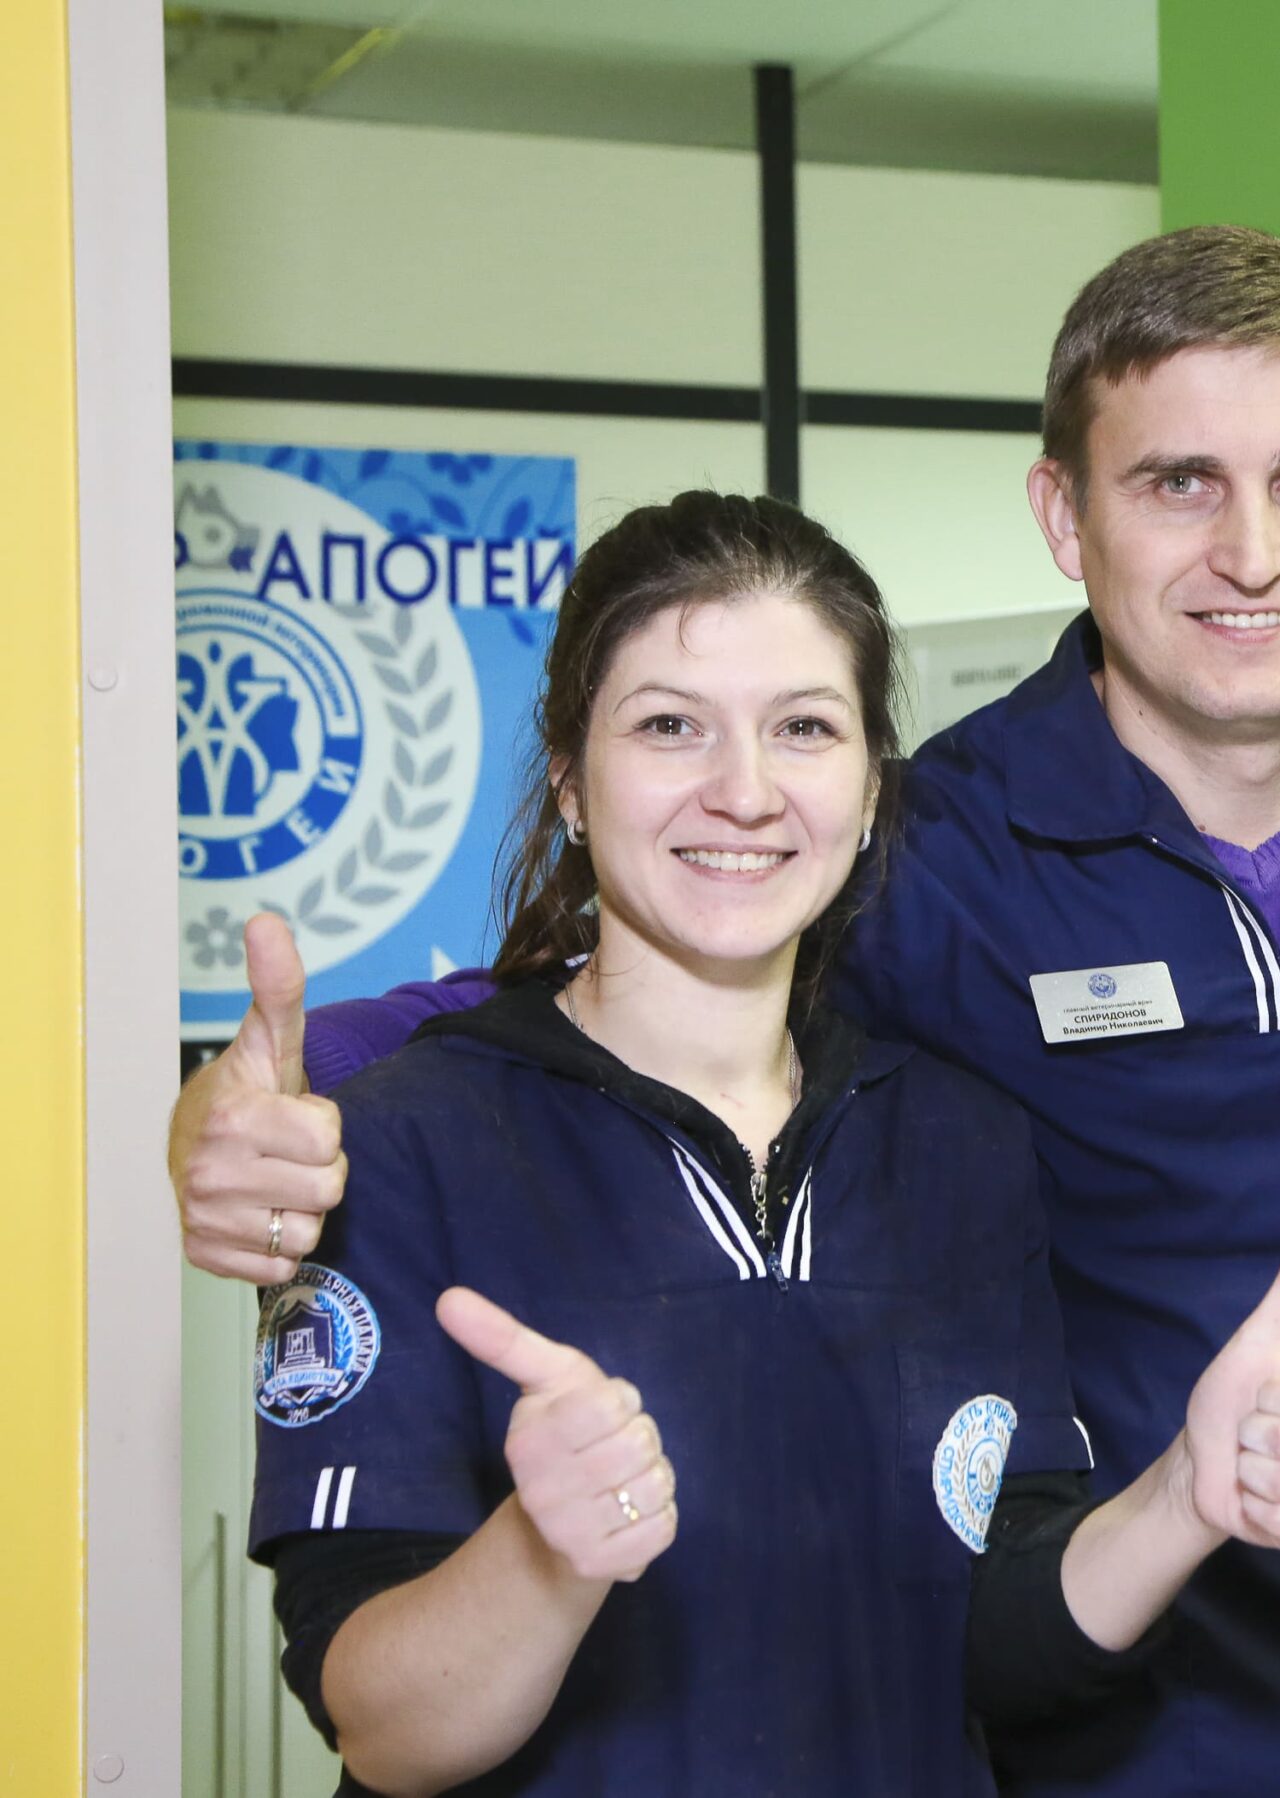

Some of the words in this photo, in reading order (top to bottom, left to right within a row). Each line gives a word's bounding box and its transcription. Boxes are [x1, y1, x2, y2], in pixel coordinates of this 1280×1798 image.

[178, 760, 359, 876] ОГЕЙ
[1063, 1024, 1108, 1035] Владимир
[1109, 1018, 1163, 1030] Николаевич
[1074, 1009, 1146, 1024] СПИРИДОНОВ
[953, 1404, 982, 1438] СЕТЬ
